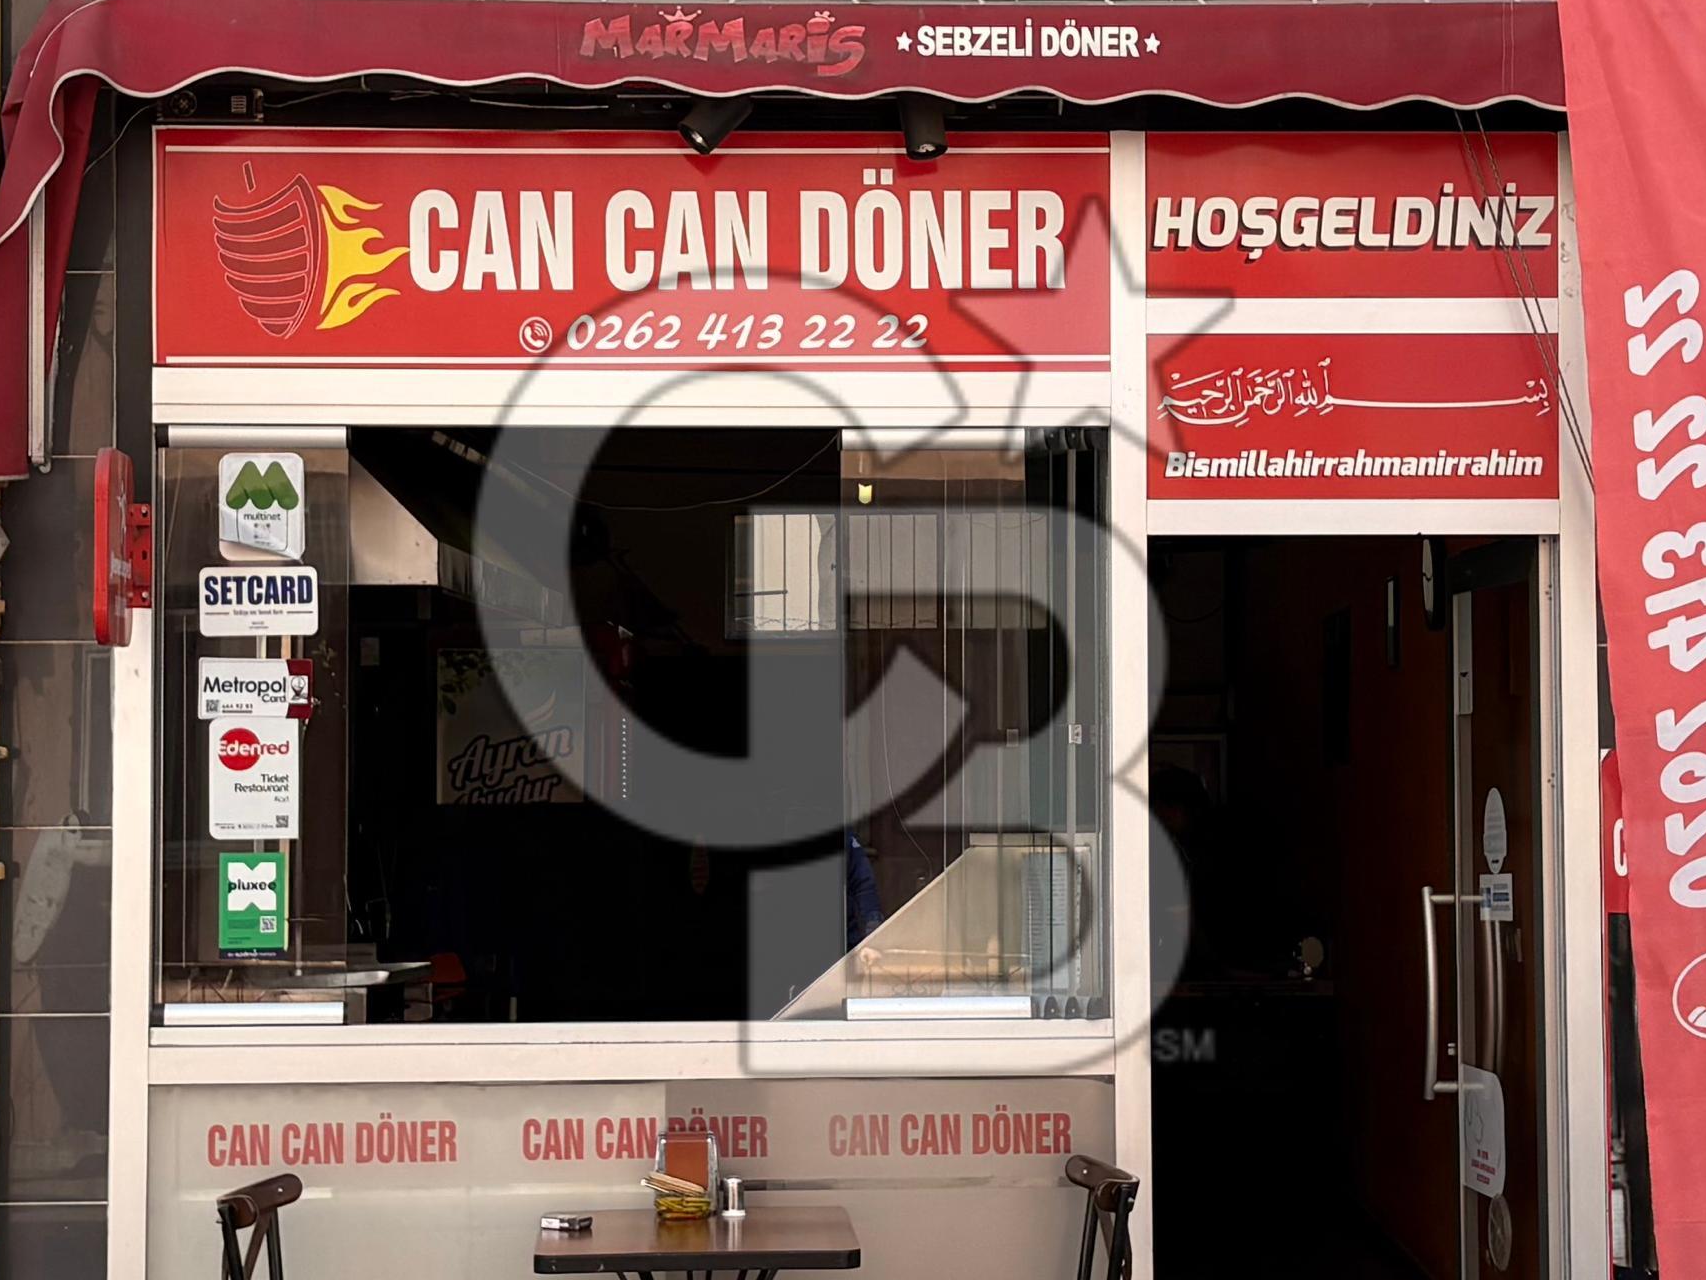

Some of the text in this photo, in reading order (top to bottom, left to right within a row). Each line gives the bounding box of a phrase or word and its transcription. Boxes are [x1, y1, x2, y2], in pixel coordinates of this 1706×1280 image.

[916, 19, 1140, 58] SEBZELİ DÖNER
[409, 168, 1066, 292] CAN CAN DÖNER
[1151, 181, 1555, 260] HOŞGELDİNİZ
[567, 313, 930, 351] 0262 413 22 22
[1163, 449, 1545, 478] Bismillahirrahmanirrahim
[243, 511, 282, 521] multinet
[204, 574, 314, 606] SETCARD
[203, 676, 287, 696] Metropol
[218, 739, 290, 756] Edenred
[448, 725, 574, 791] Ayran
[234, 782, 289, 793] Restaurant
[261, 773, 289, 783] Ticket
[228, 879, 277, 893] pluxee
[207, 1113, 458, 1167] CAN CAN DÖNER
[522, 1118, 584, 1160] CAN
[595, 1117, 657, 1160] CAN
[829, 1104, 1073, 1158] CAN CAN DÖNER
